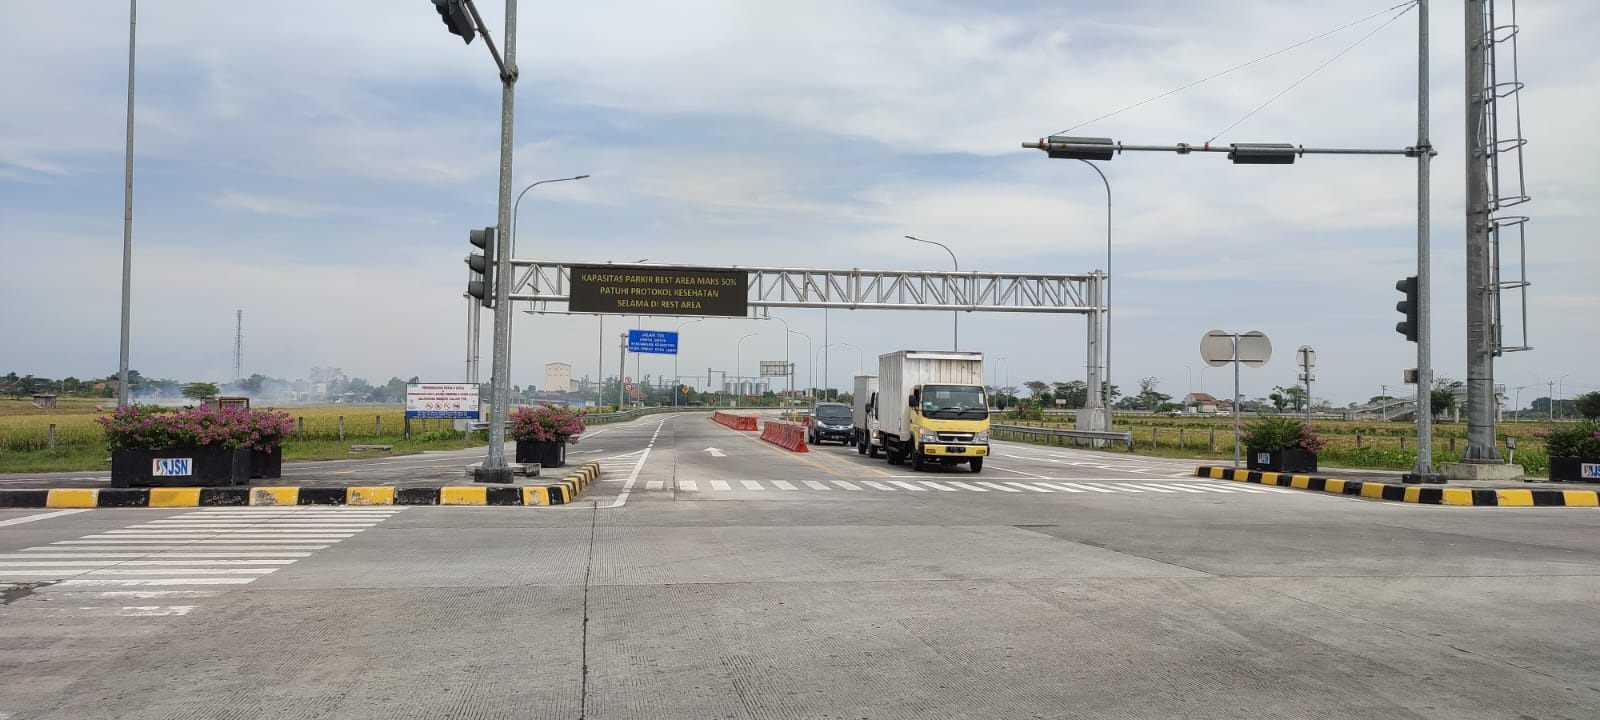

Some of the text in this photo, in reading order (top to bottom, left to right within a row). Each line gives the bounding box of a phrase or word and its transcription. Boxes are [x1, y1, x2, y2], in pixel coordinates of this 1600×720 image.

[581, 273, 737, 287] KAPASITAS PARKIR REST AREA MAKS 50%
[600, 286, 719, 298] PATUHI PROTOKOL KESEHATAN
[617, 299, 701, 309] SELAMA DI REST AREA
[168, 459, 188, 475] JSN
